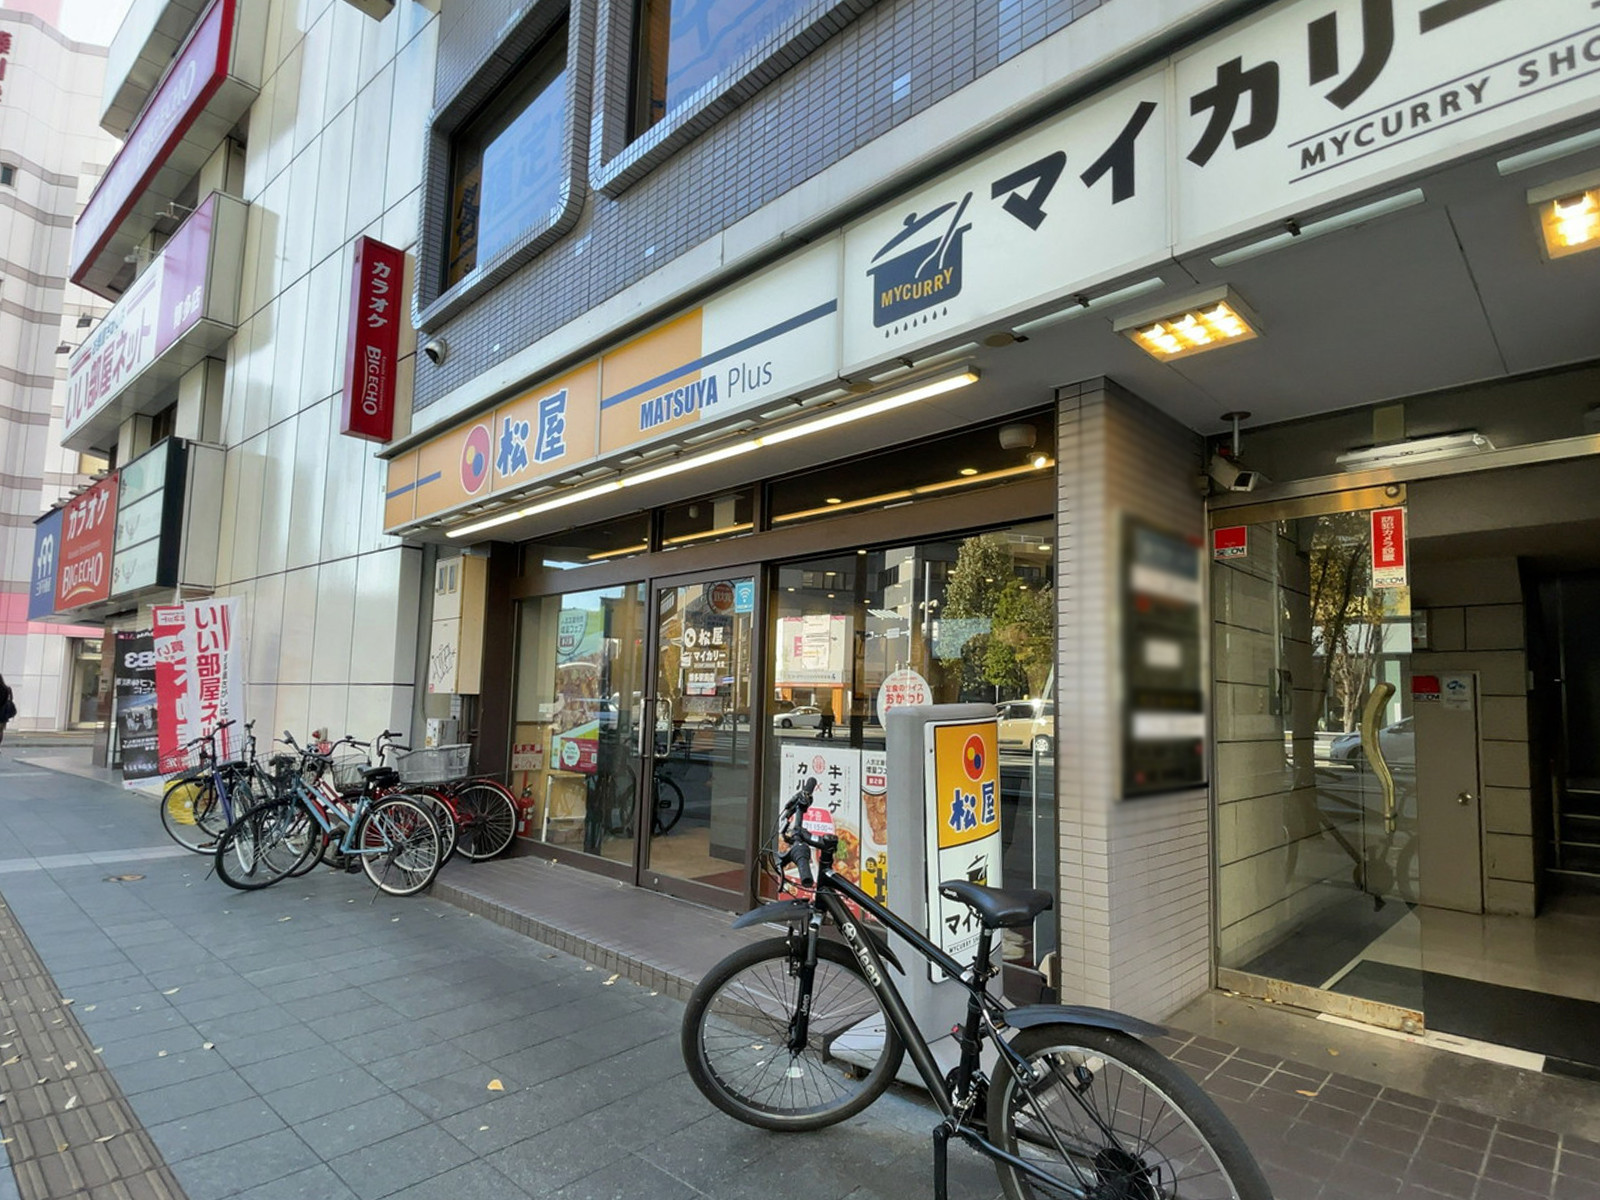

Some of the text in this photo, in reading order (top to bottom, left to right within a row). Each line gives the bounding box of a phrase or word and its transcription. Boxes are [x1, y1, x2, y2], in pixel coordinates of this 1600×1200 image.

[1299, 77, 1491, 171] MYCURRY
[367, 261, 391, 328] カラオケ
[880, 266, 953, 308] MYCURRY
[639, 359, 772, 432] MATSUYA Plus
[496, 388, 568, 478] 松屋
[67, 488, 110, 541] カラオケ
[1216, 547, 1245, 556] SECOM
[1375, 577, 1404, 585] SECOM
[693, 650, 726, 662] マイカリー
[698, 626, 724, 646] 松屋
[828, 764, 843, 814] 牛チゲ
[949, 780, 997, 834] 松屋
[857, 947, 881, 987] Jeep
